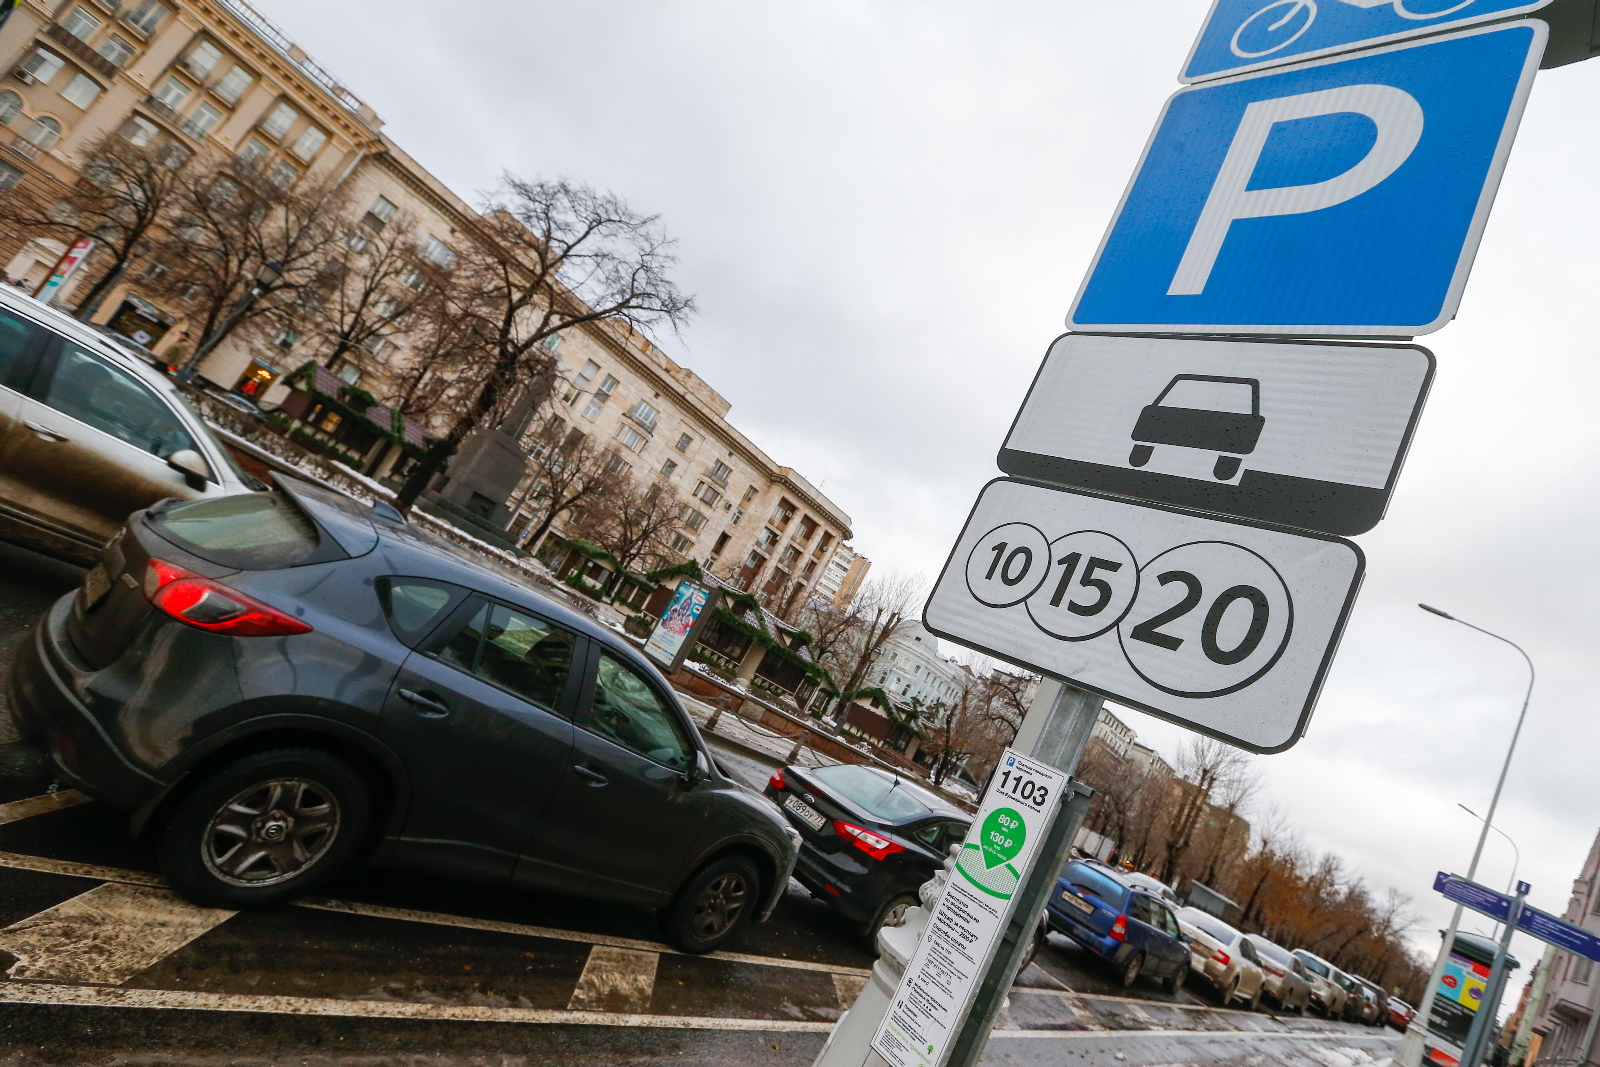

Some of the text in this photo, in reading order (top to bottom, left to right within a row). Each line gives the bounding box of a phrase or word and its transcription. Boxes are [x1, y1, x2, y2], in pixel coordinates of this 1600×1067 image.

[1166, 82, 1425, 297] P
[984, 541, 1270, 666] 10 15 20
[1000, 770, 1048, 806] 1103
